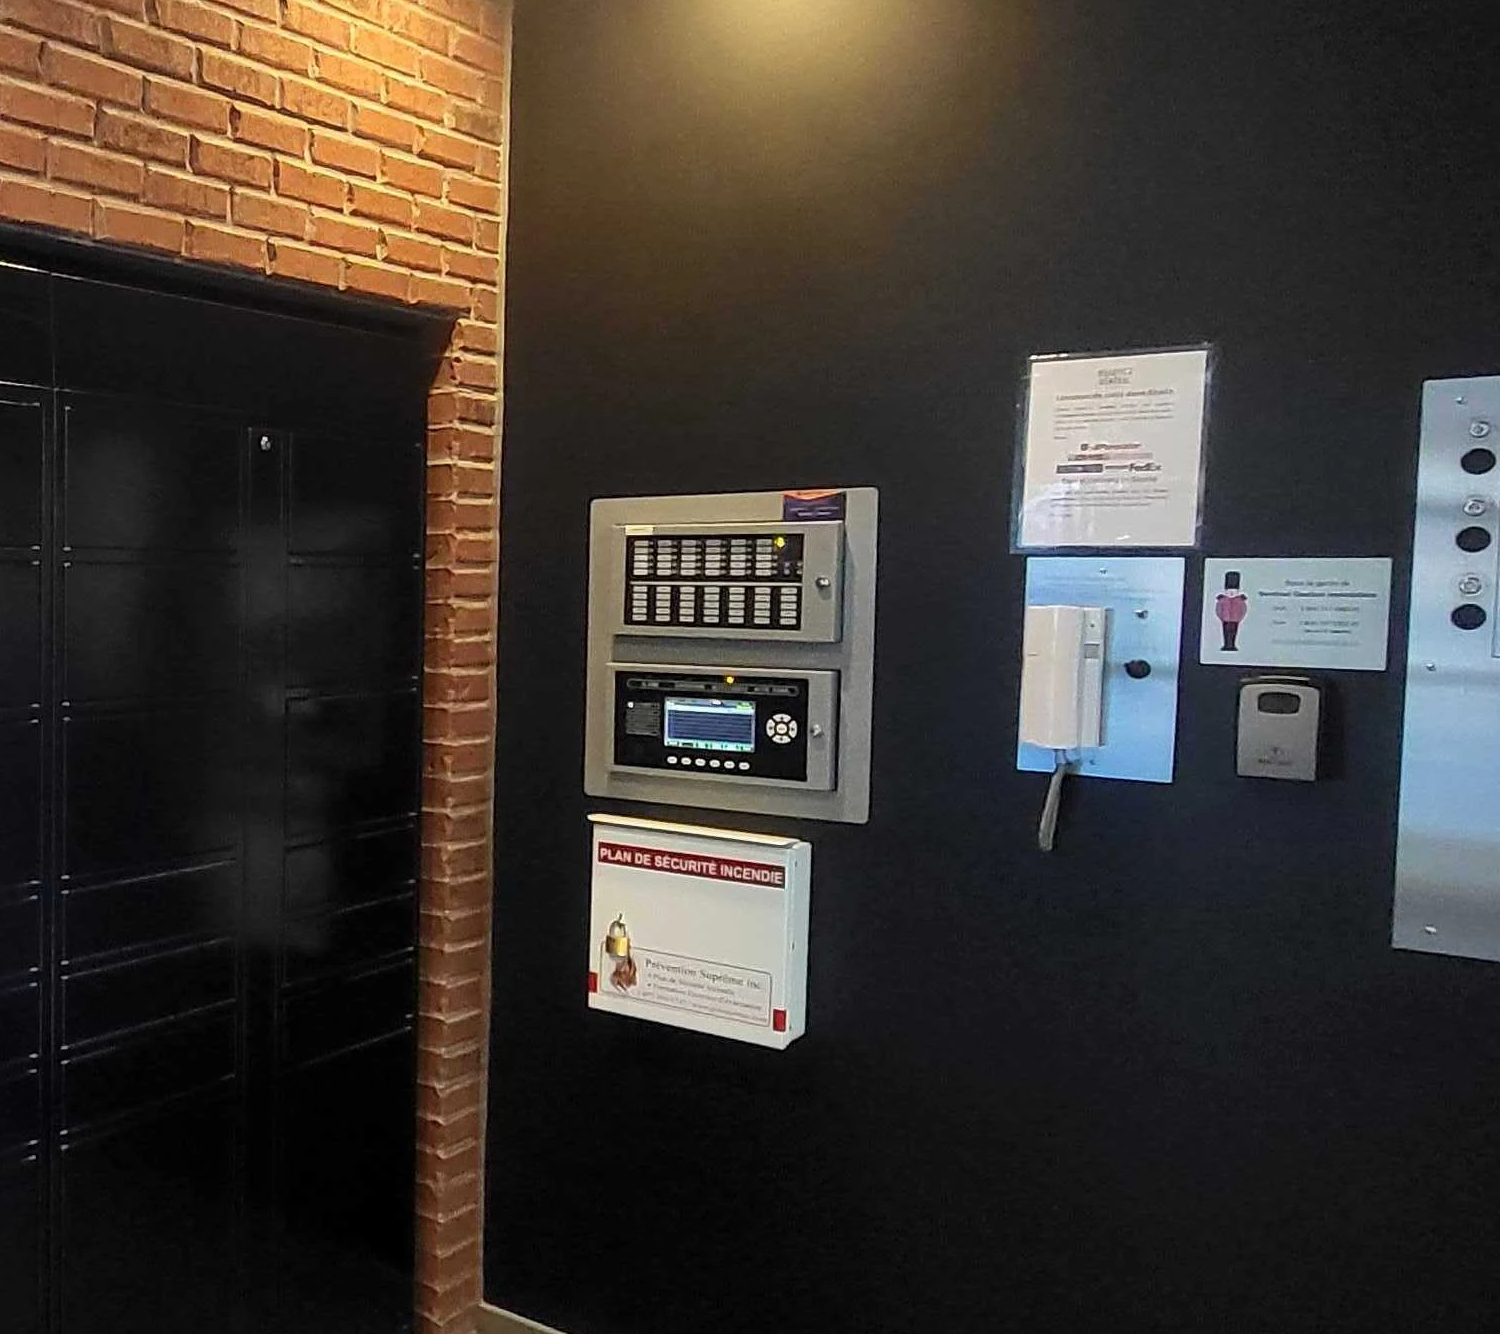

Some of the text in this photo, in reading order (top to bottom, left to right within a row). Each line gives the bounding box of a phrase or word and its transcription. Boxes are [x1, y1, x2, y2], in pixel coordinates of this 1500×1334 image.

[1129, 462, 1162, 473] FedEx
[600, 847, 784, 885] PLAN DE SÉCURITÉ INCENDIE
